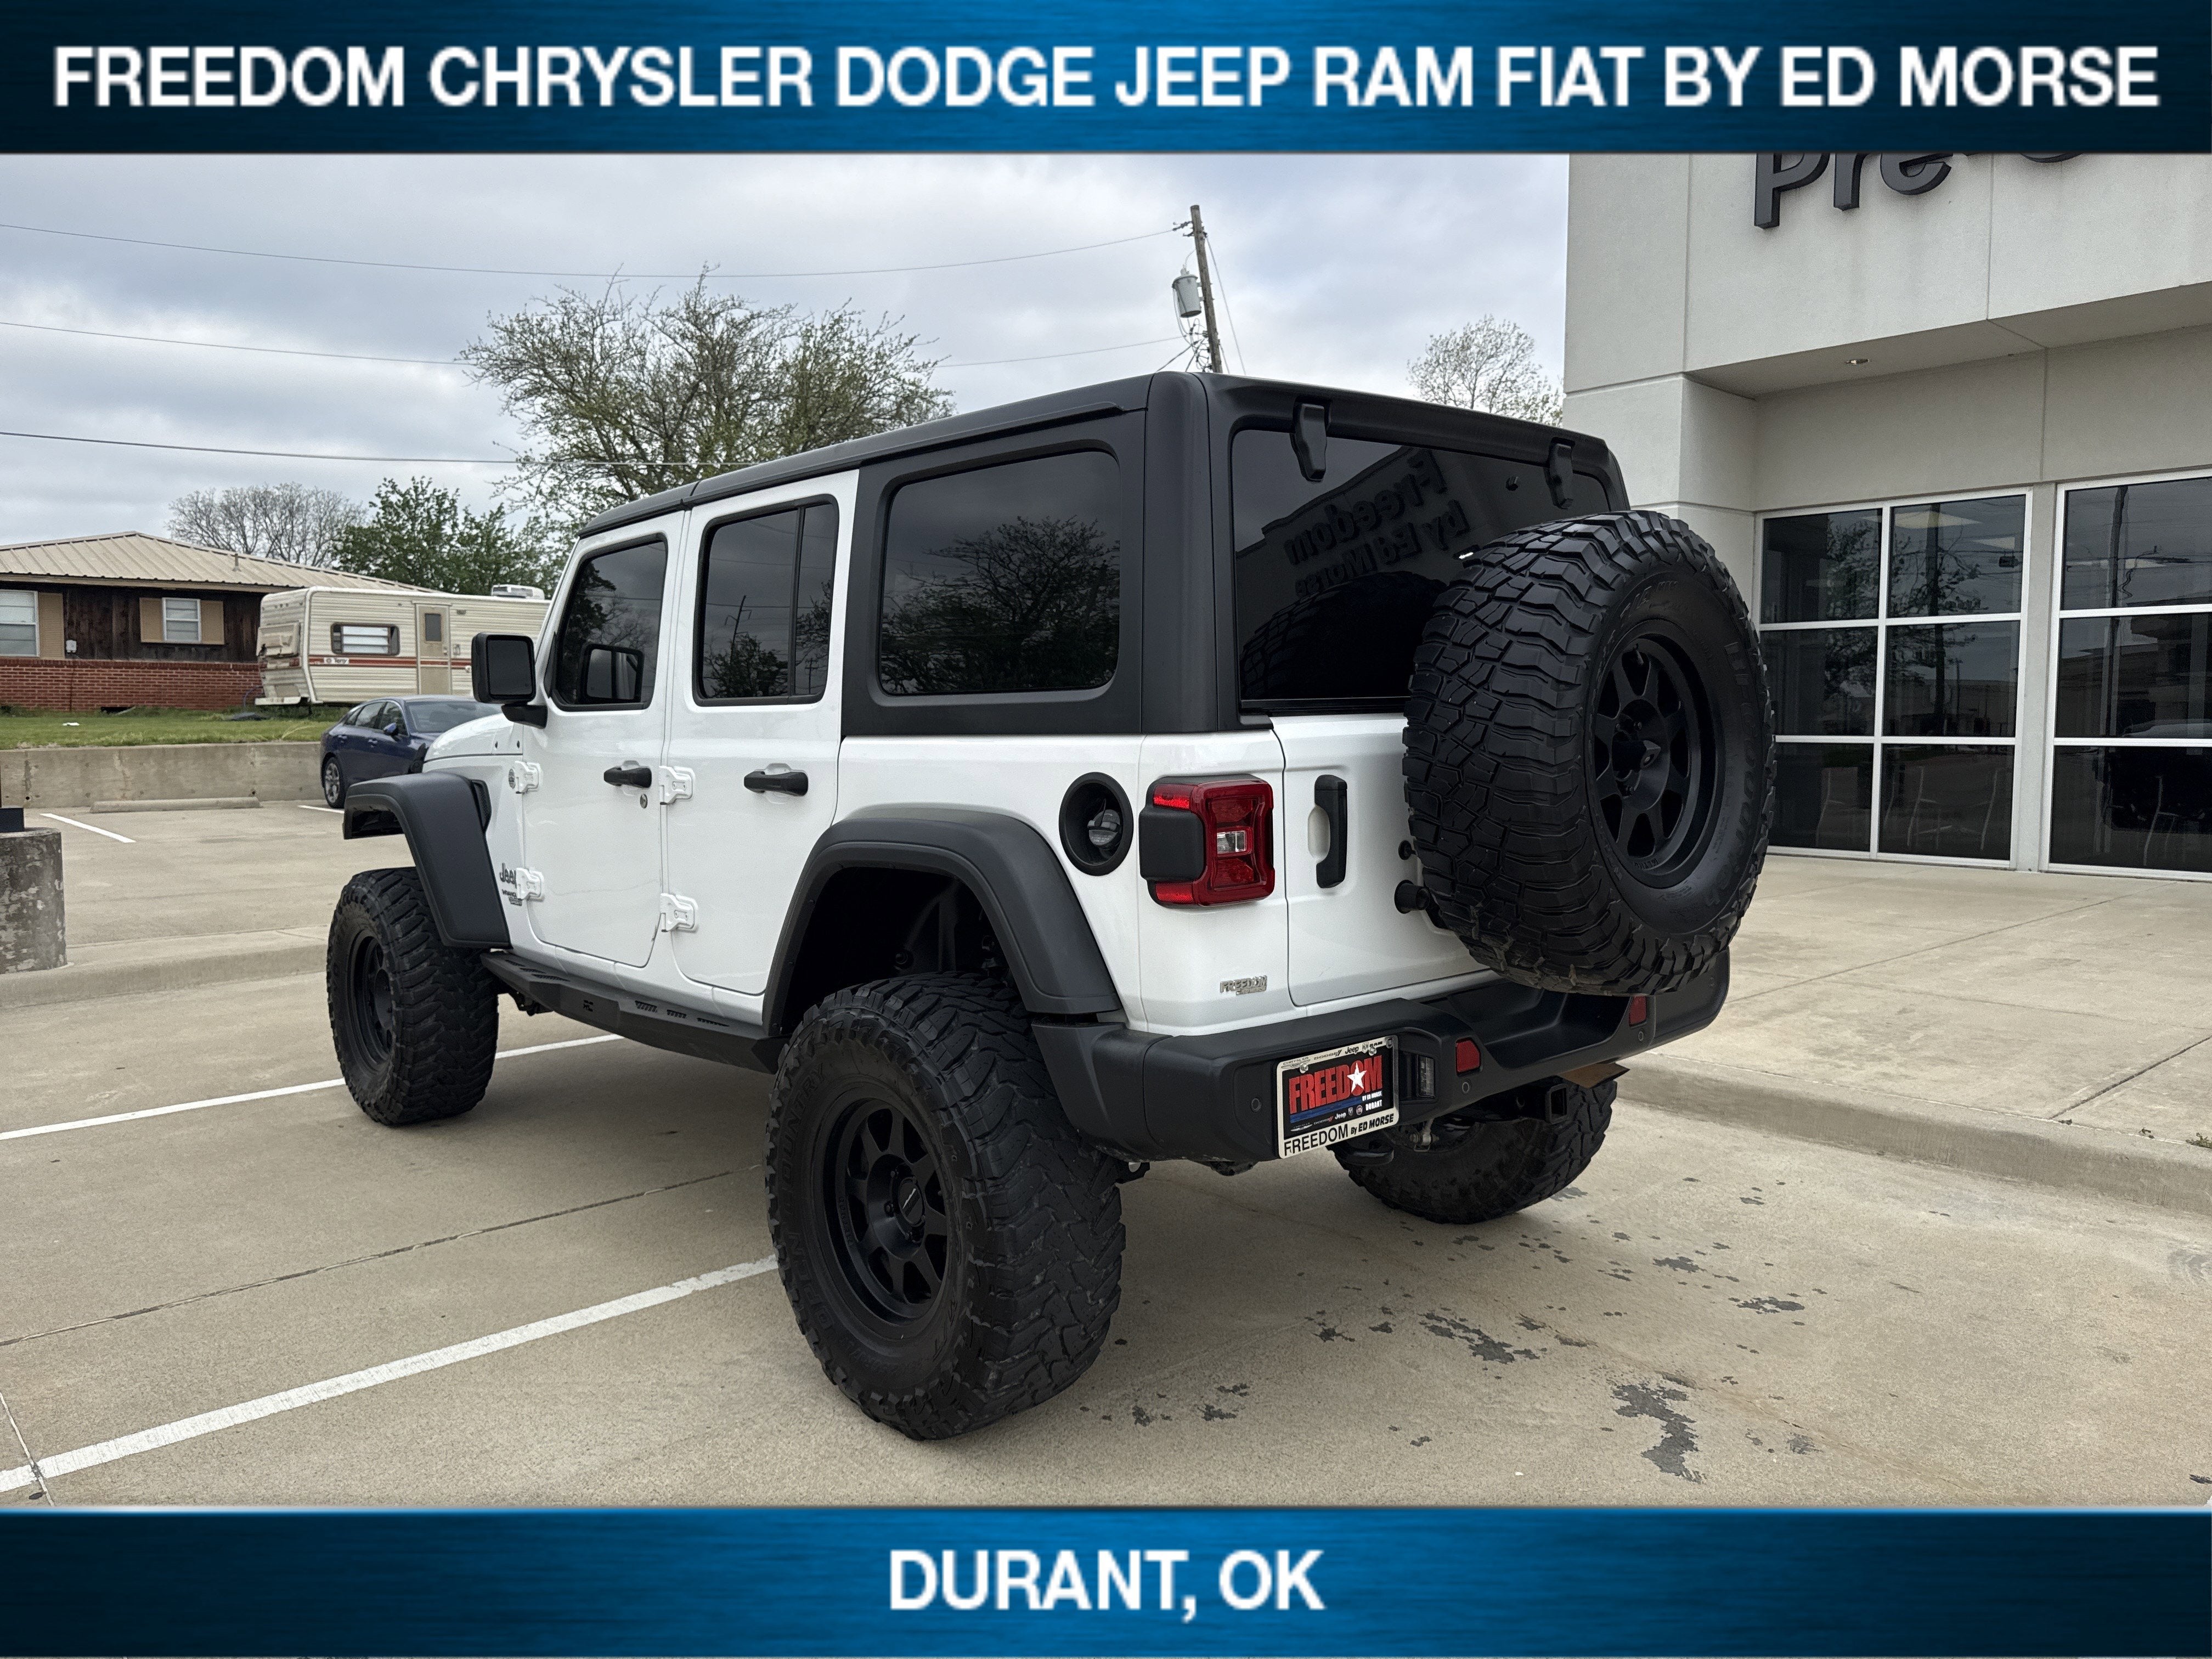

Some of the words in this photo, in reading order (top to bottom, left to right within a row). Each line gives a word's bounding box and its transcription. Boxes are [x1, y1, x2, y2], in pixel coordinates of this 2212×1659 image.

[1345, 1046, 1359, 1054] Jeep
[1289, 1054, 1383, 1115] FREEDOM
[1365, 1099, 1383, 1111] DURANT
[1284, 1124, 1349, 1156] FREEDOM
[1358, 1121, 1368, 1133] ED
[1368, 1113, 1394, 1130] MORSE
